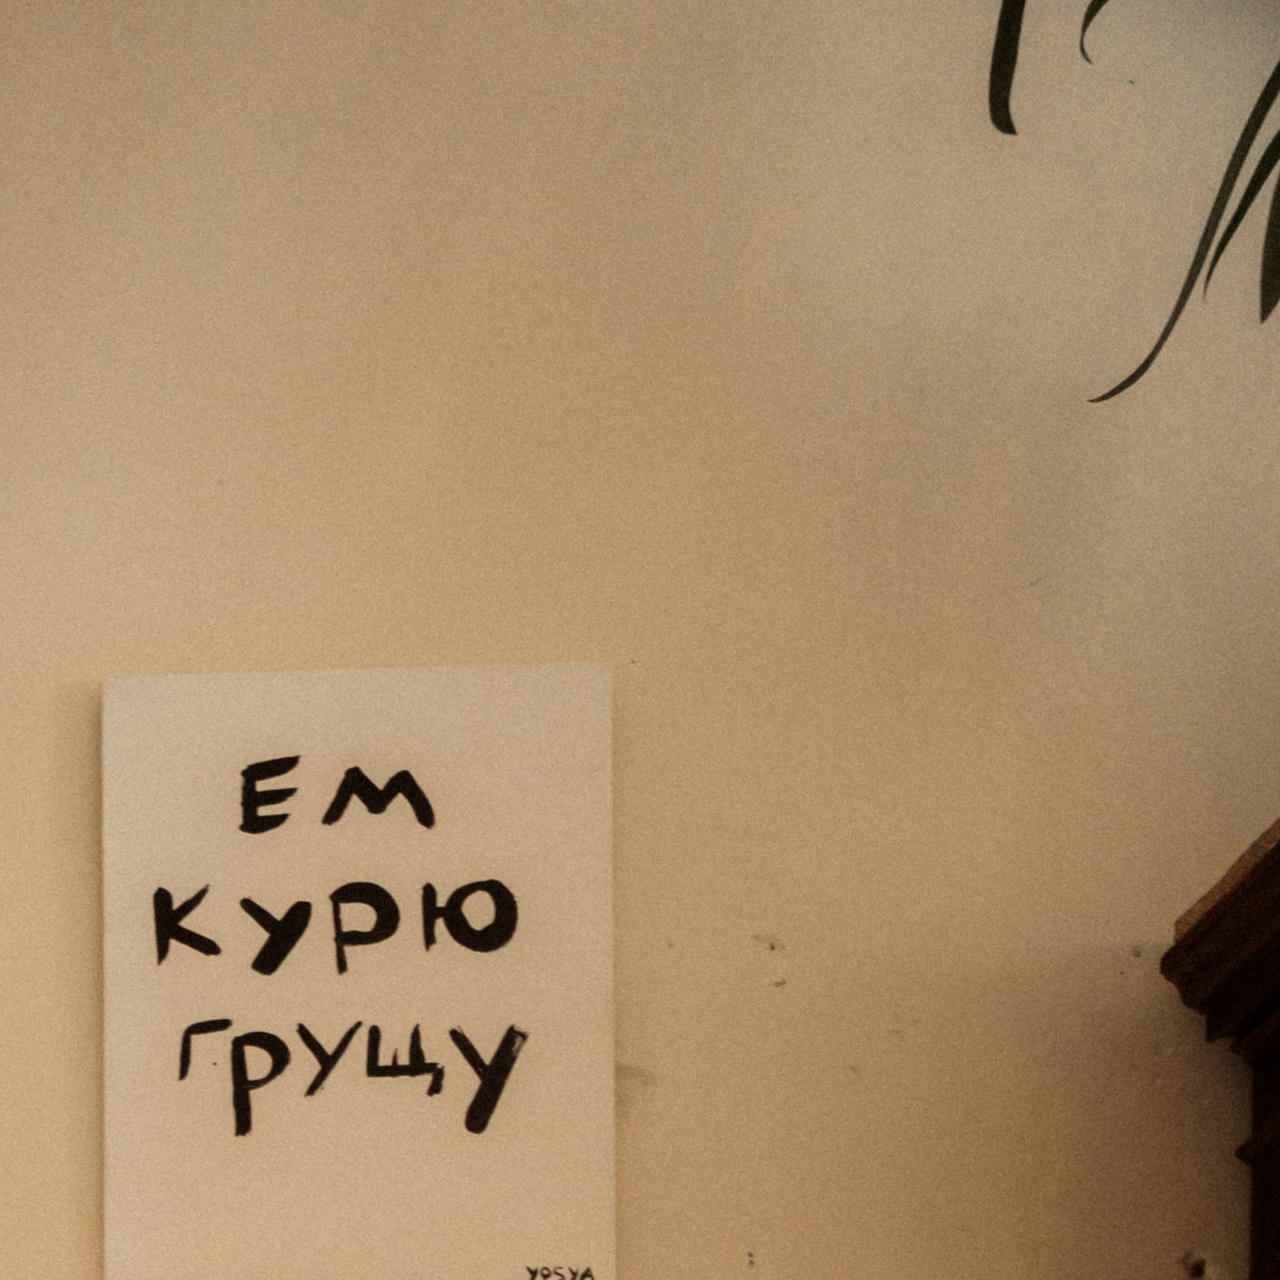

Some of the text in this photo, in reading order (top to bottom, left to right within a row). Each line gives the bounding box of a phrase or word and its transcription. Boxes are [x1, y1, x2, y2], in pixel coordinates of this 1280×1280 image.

[239, 755, 437, 835] ЕМ
[153, 878, 519, 977] КУРЮ
[178, 1019, 529, 1138] ГРУЩУ
